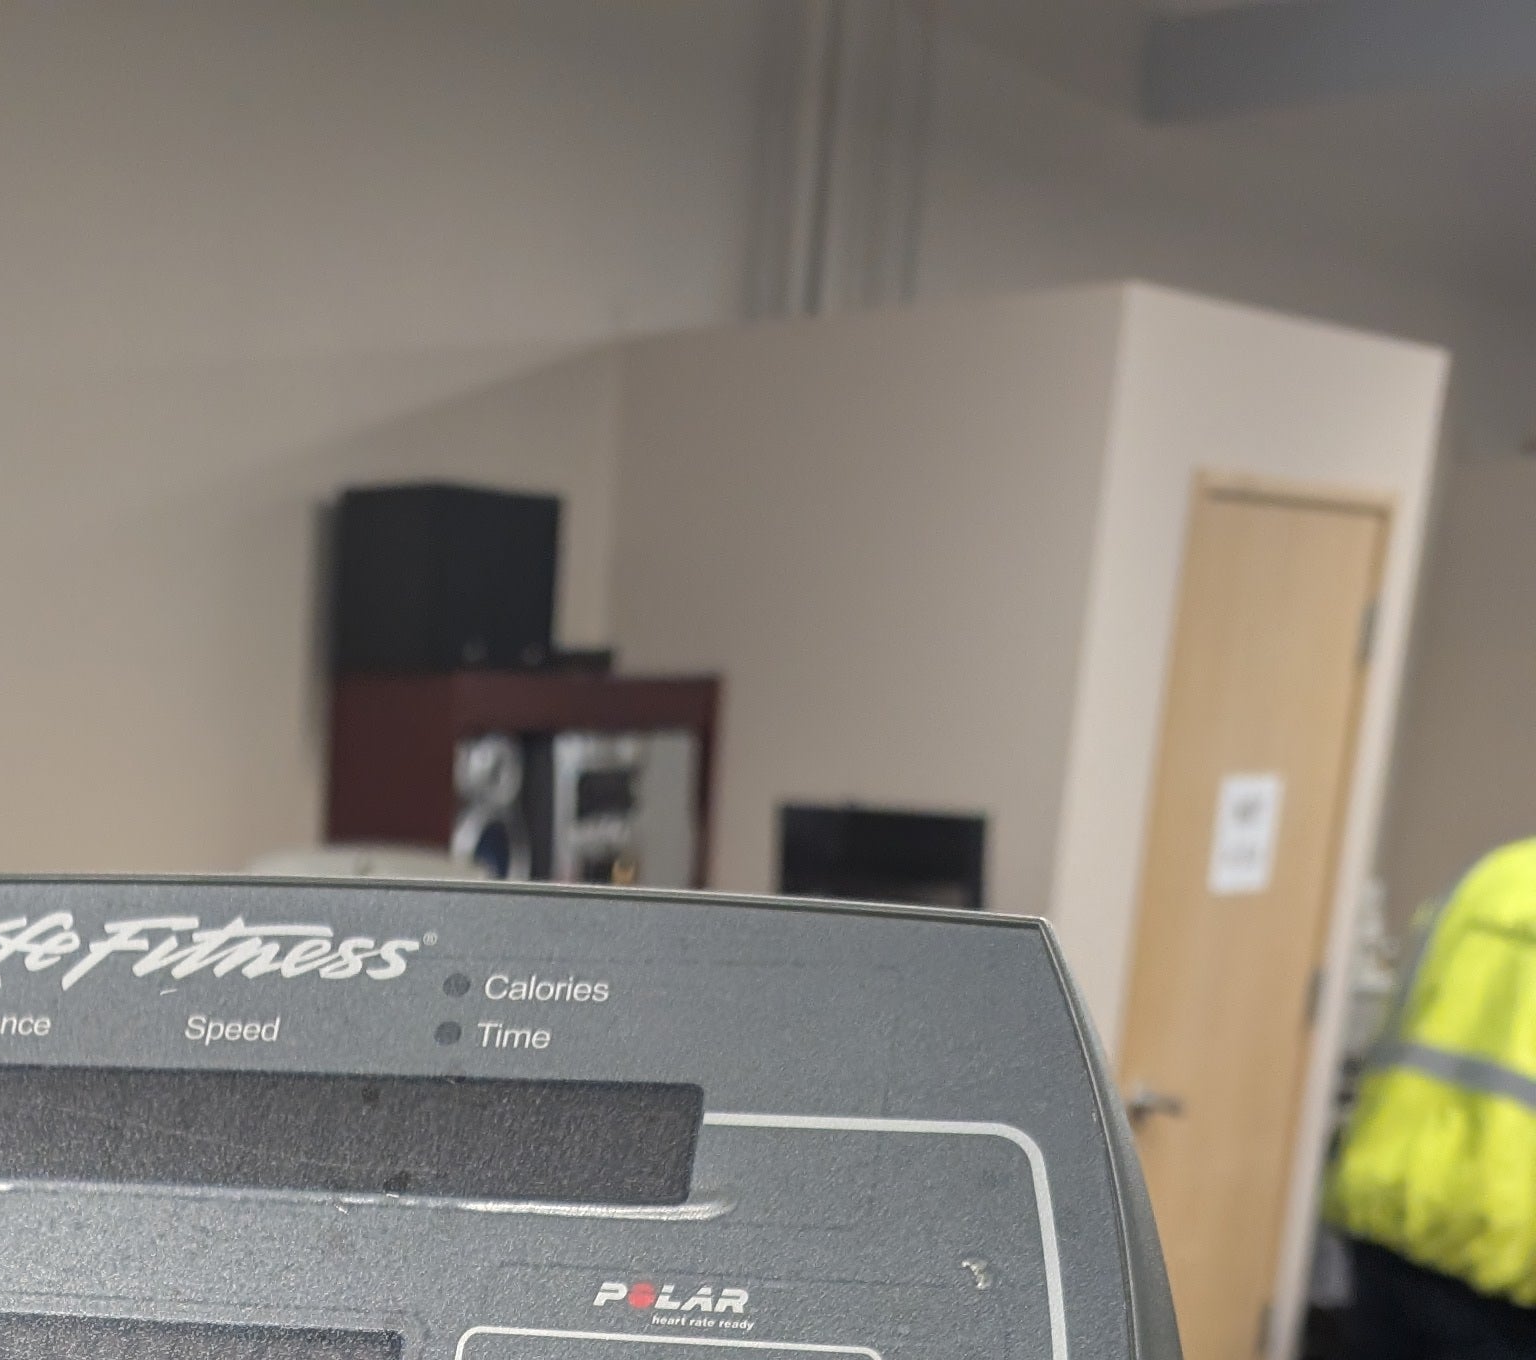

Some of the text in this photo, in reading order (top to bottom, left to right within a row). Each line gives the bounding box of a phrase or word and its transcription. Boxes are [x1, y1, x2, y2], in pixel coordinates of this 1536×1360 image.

[484, 974, 610, 1003] Calories
[184, 1015, 281, 1045] Speed
[477, 1022, 552, 1050] Time
[651, 1314, 755, 1332] heart rate ready
